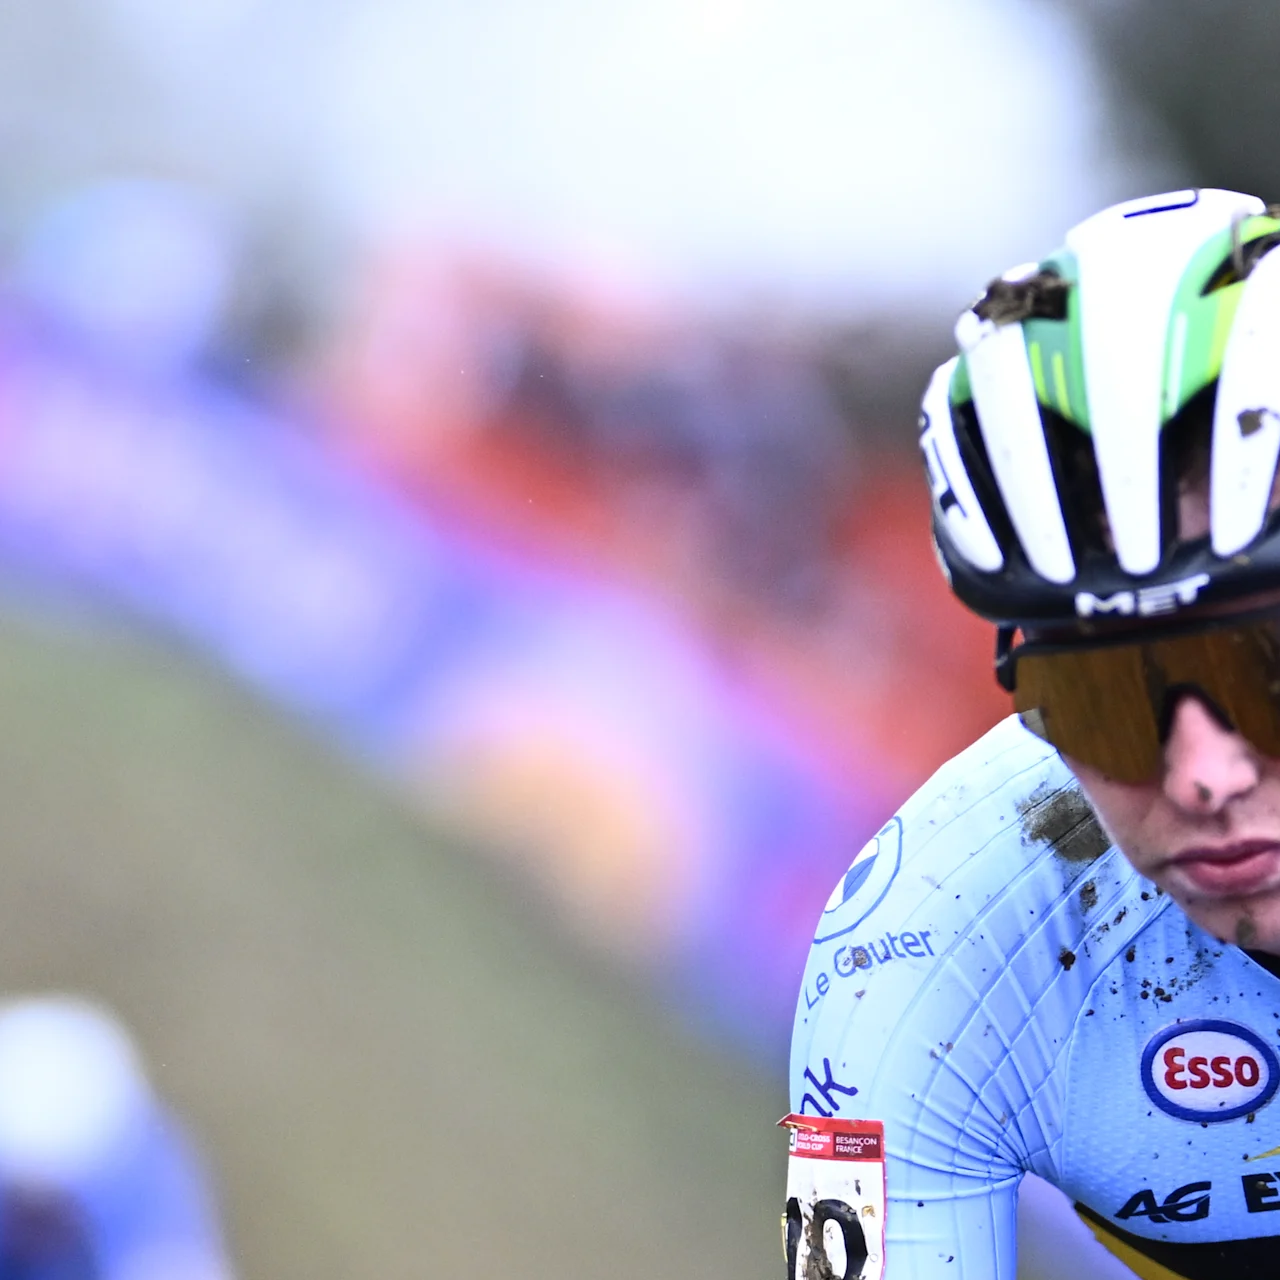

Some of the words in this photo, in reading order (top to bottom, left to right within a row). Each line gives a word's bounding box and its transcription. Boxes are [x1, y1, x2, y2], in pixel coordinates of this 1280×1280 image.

[1075, 572, 1211, 617] MET
[805, 972, 830, 1010] Le
[834, 930, 936, 978] Couter
[1163, 1047, 1260, 1090] Esso
[835, 1136, 877, 1147] BESANÇON
[835, 1144, 863, 1154] FRANCE
[1114, 1181, 1212, 1223] AG
